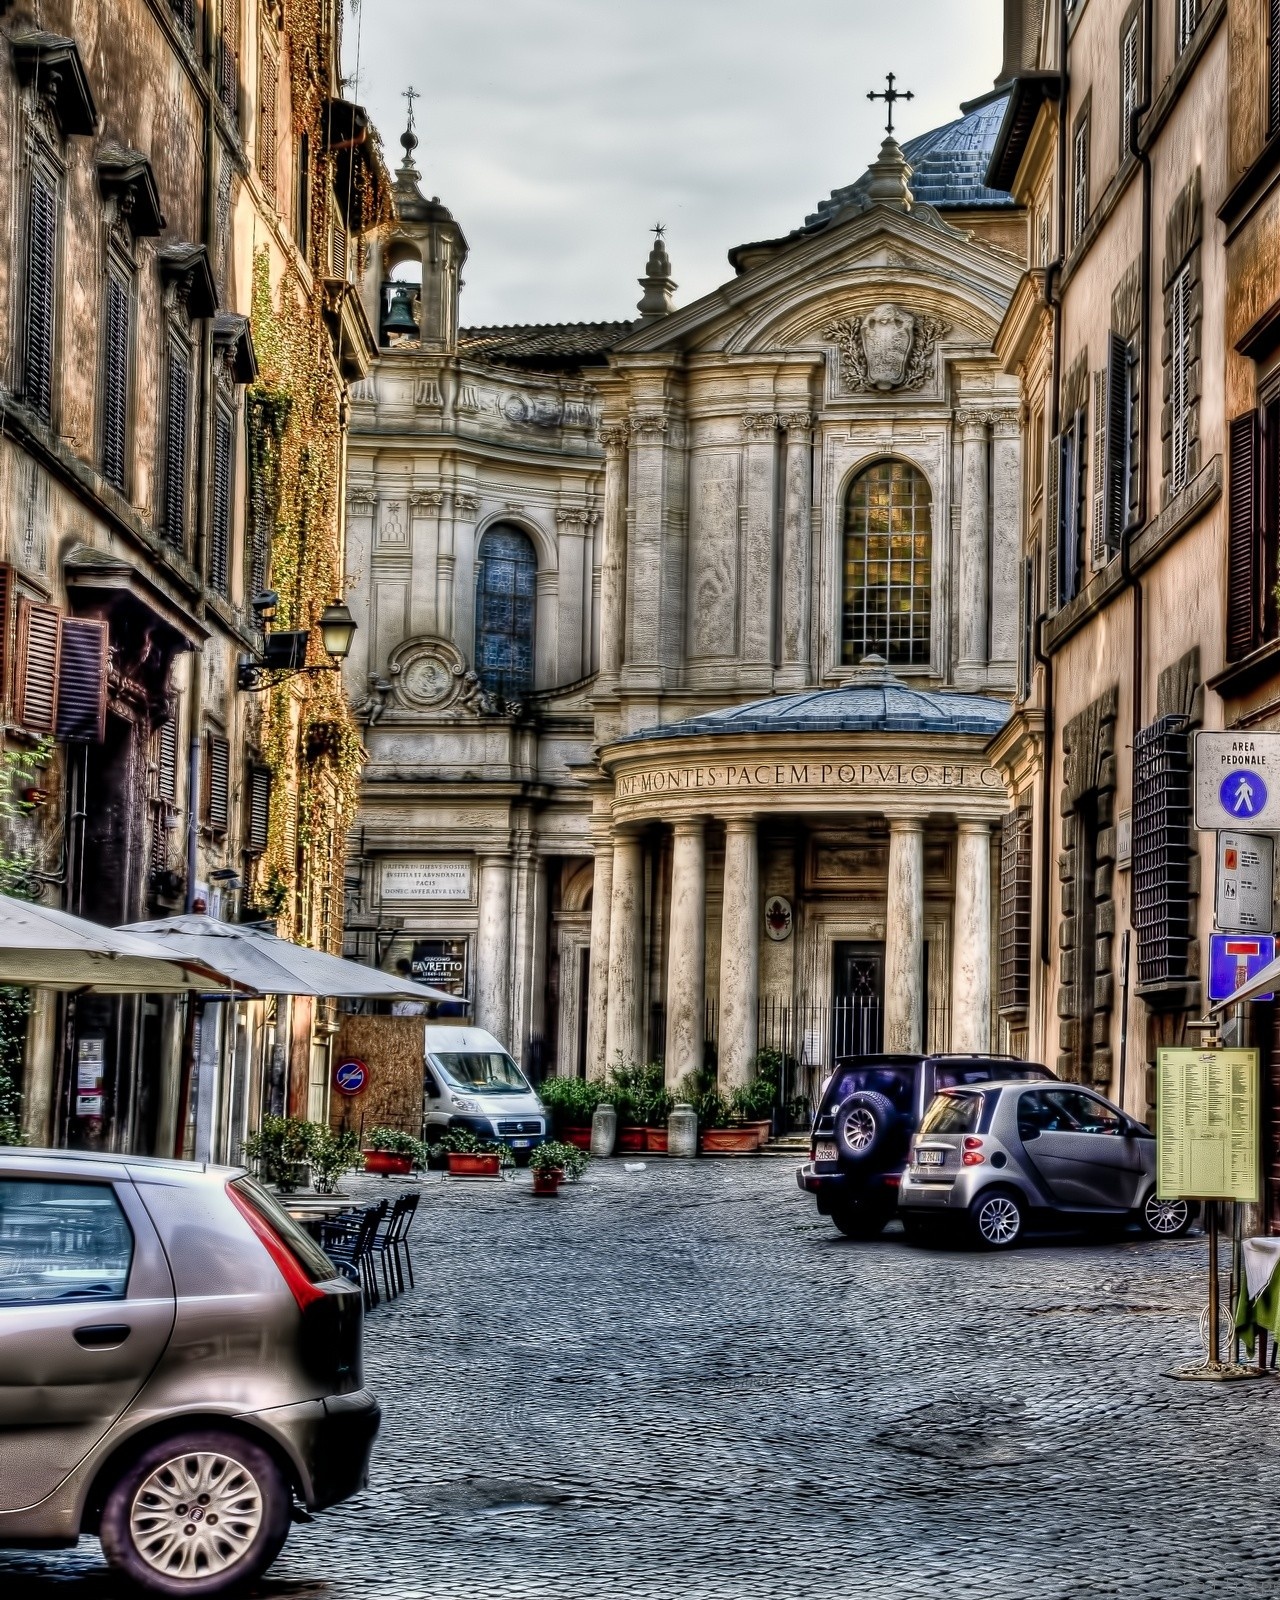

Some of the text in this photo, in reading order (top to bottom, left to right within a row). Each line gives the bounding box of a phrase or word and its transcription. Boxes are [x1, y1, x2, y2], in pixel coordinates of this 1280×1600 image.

[1232, 742, 1255, 751] AREA
[1221, 755, 1266, 765] PEDONALE
[640, 767, 716, 792] MONTES
[726, 765, 810, 786] PACEM
[821, 763, 929, 785] POPVLO
[942, 766, 970, 785] ET
[980, 766, 1004, 787] C
[412, 961, 463, 971] FAVRETTO
